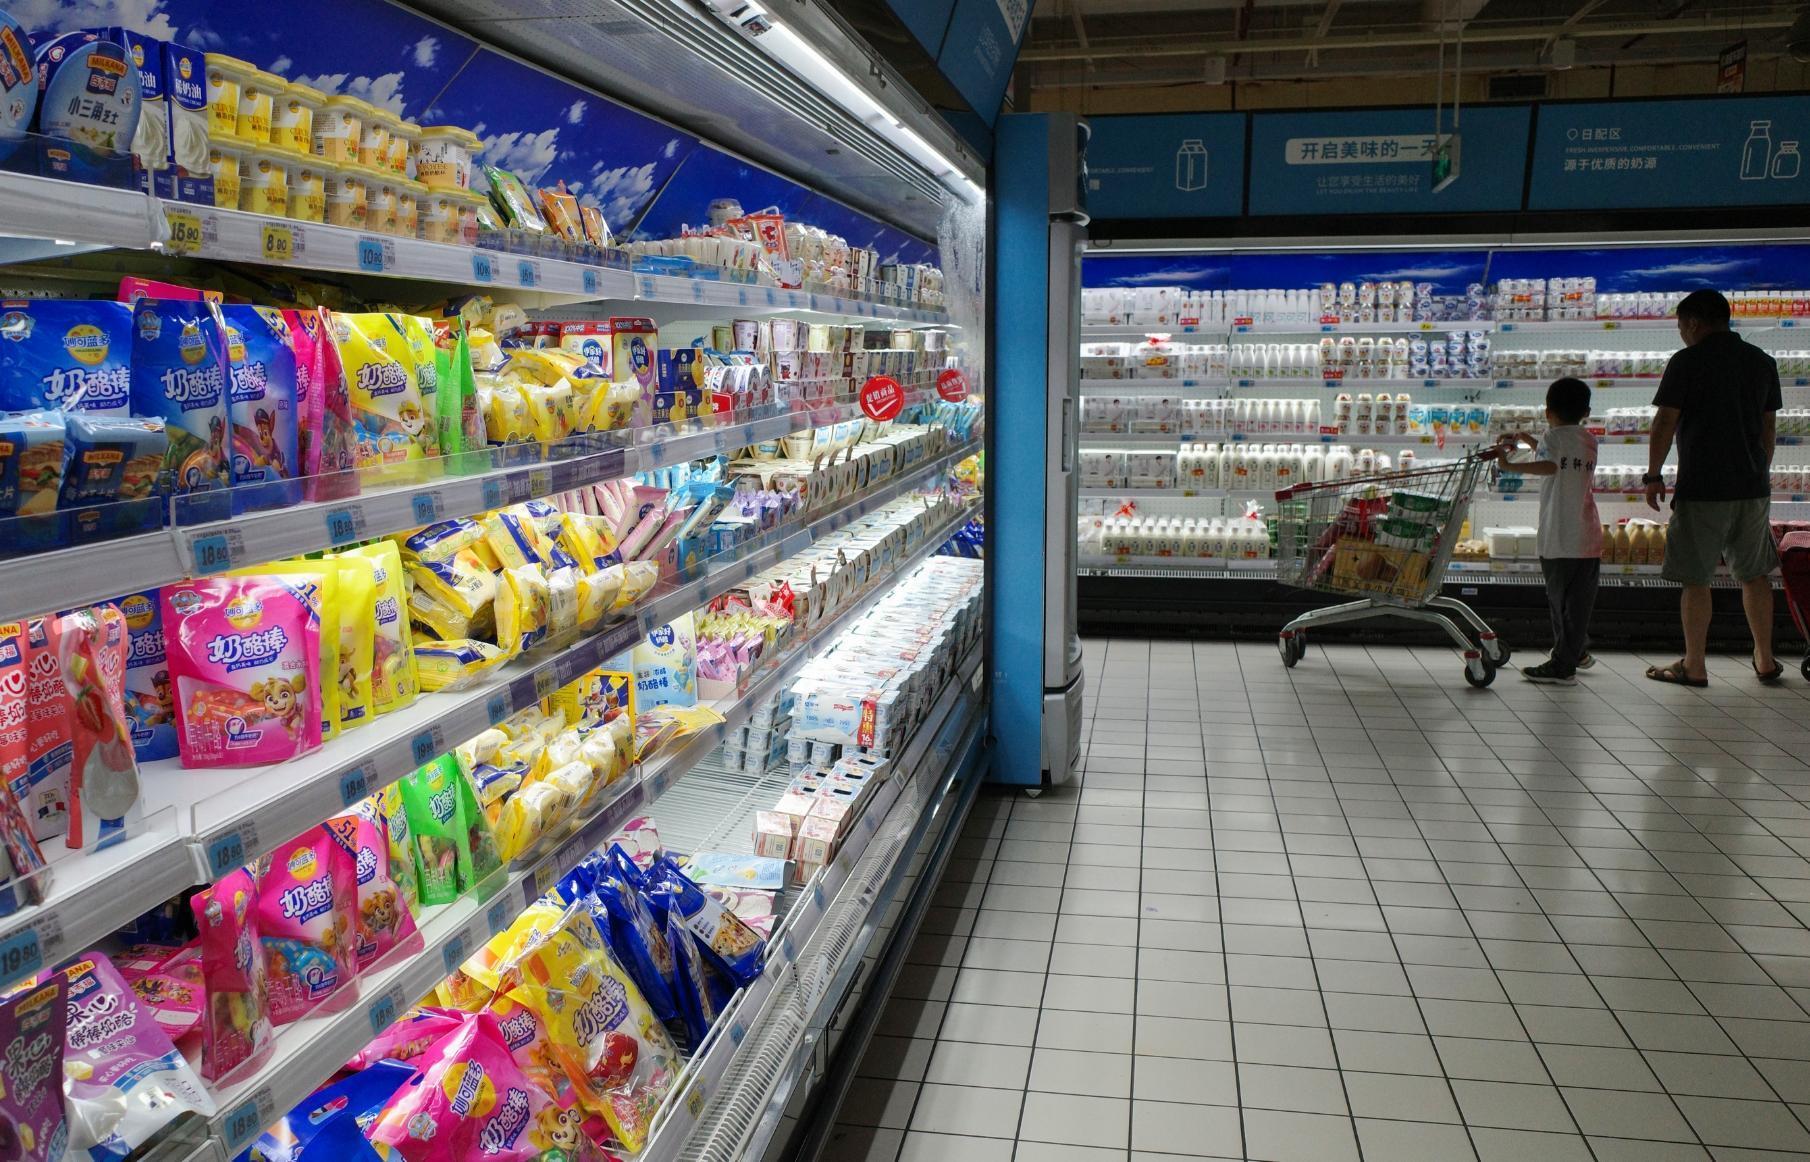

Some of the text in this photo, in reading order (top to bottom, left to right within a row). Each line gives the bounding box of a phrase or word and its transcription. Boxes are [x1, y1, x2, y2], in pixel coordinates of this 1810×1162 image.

[175, 78, 202, 100] 稀奶油
[68, 96, 119, 125] 小三角芝士
[1581, 129, 1622, 141] 日配区
[1564, 158, 1658, 172] 源于优质的奶源
[357, 361, 406, 391] 奶酪棒
[208, 625, 288, 663] 奶酪棒
[71, 1011, 134, 1048] 棒棒奶酪
[480, 1088, 530, 1155] 奶酪棒
